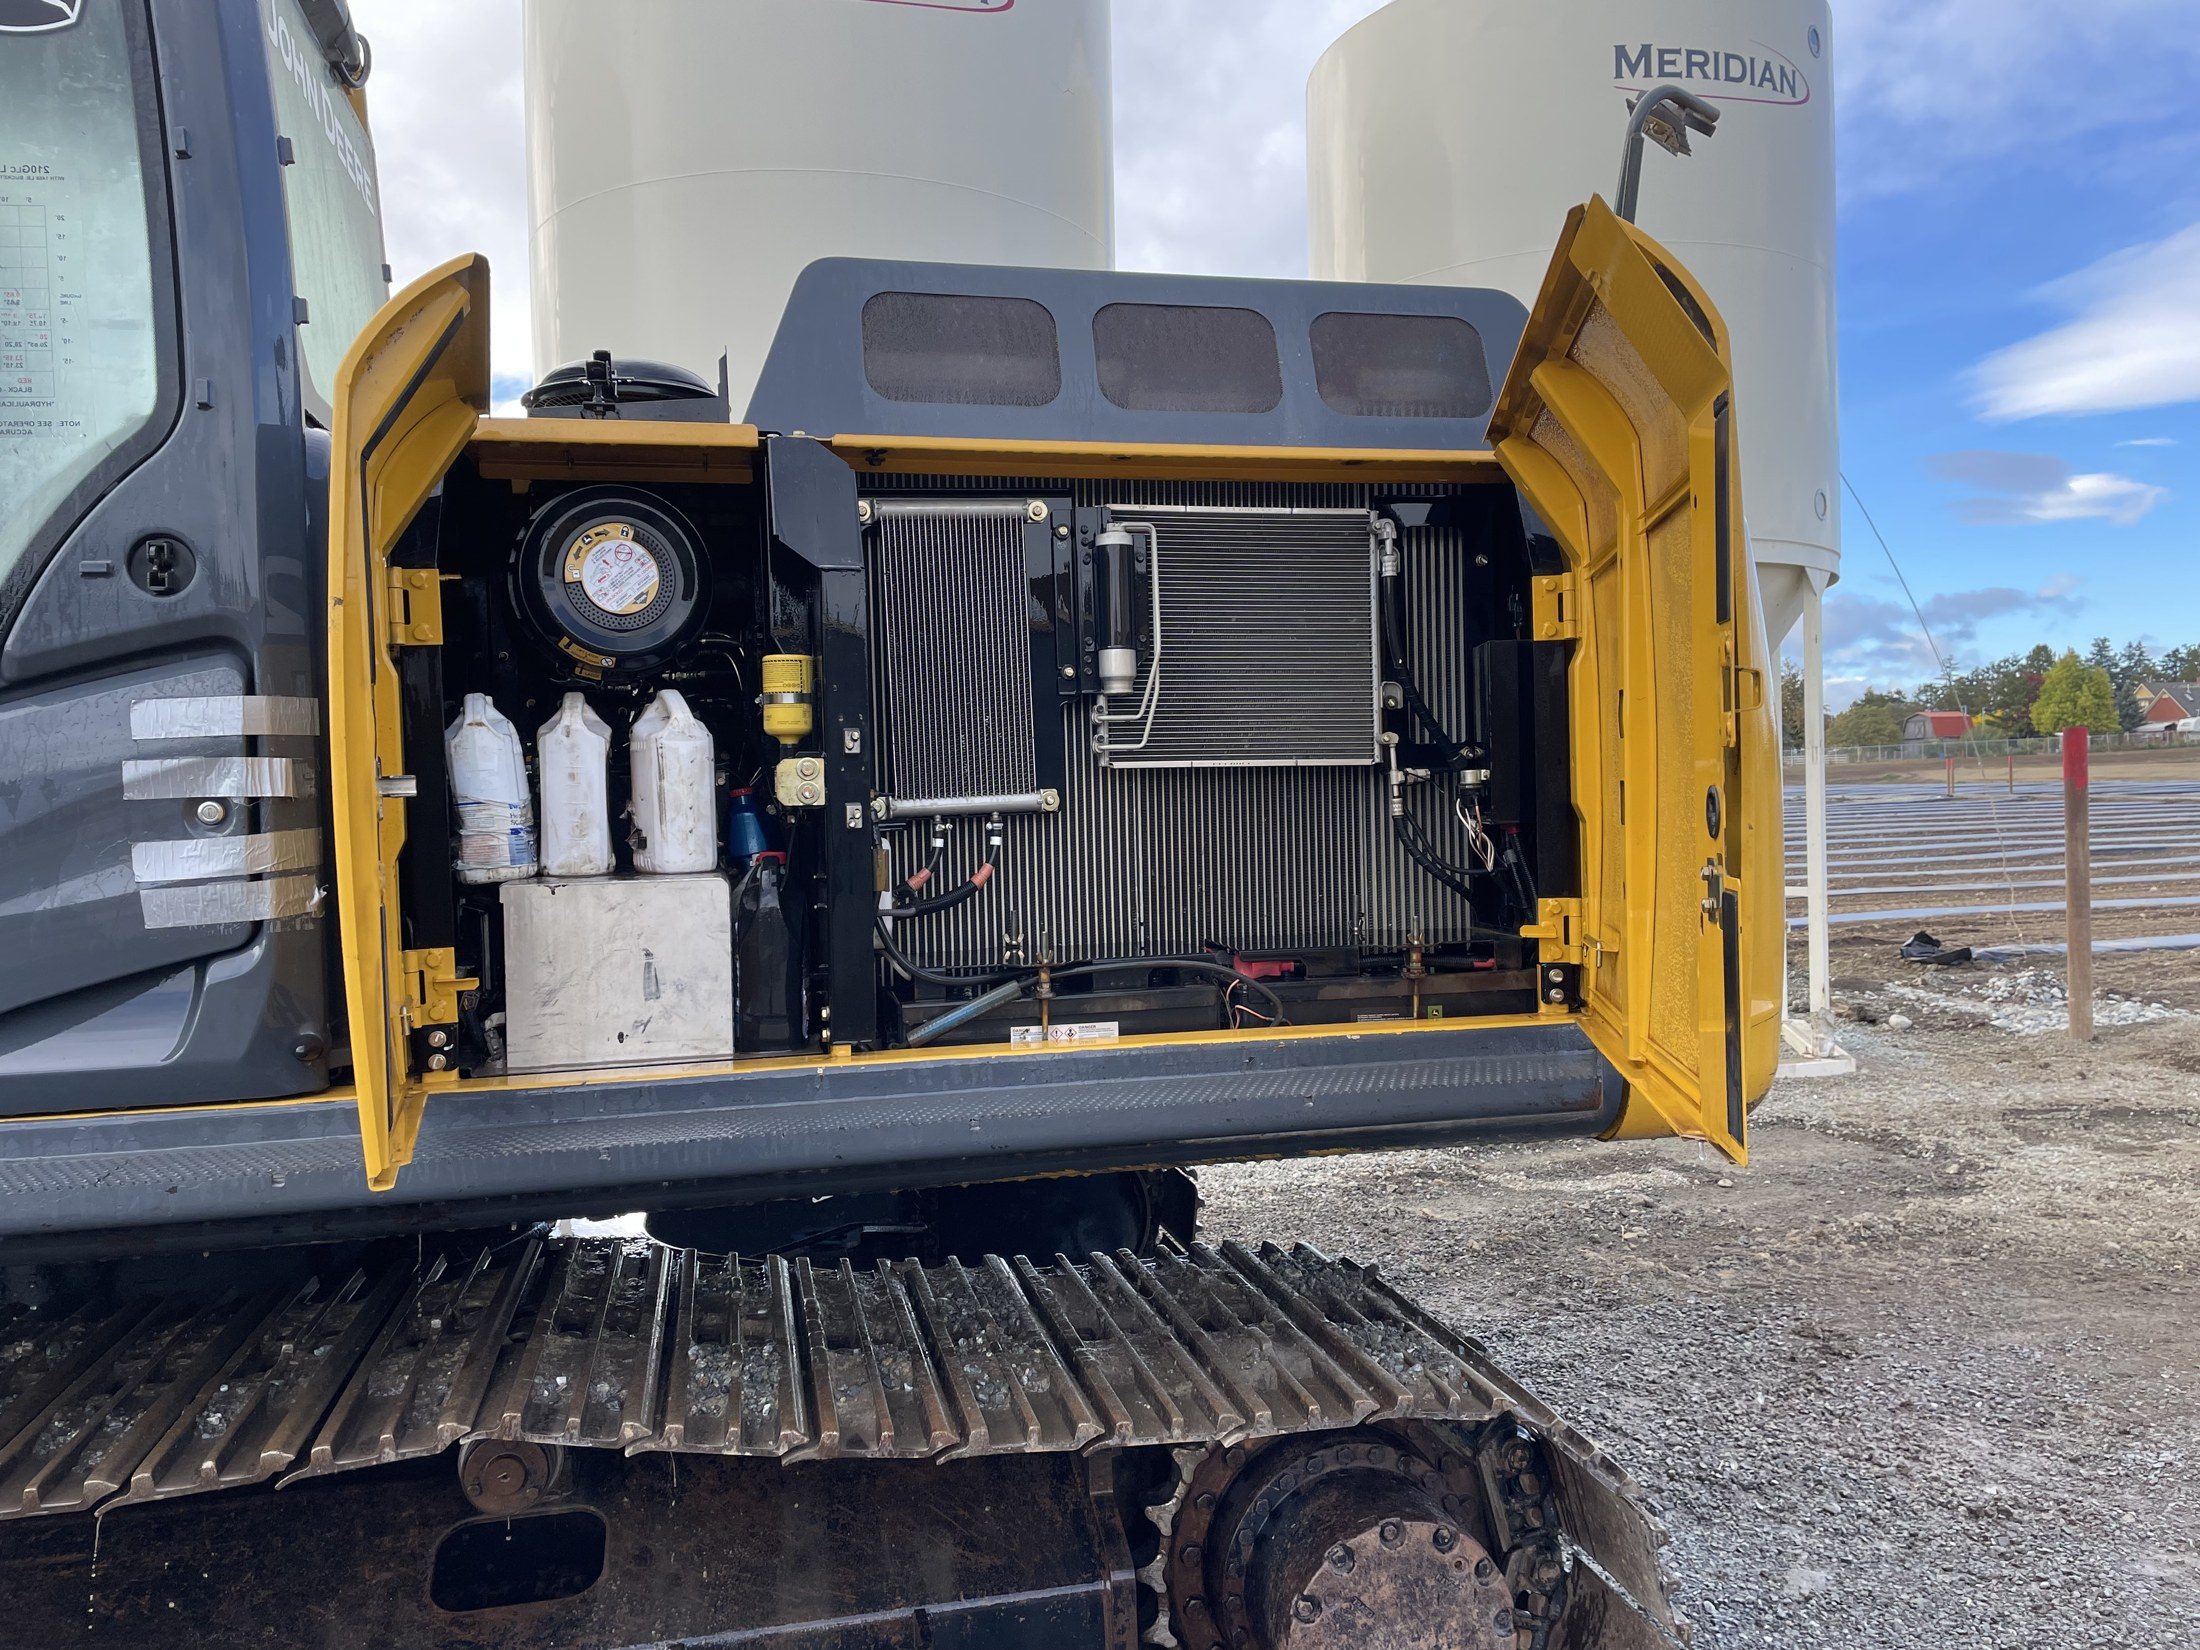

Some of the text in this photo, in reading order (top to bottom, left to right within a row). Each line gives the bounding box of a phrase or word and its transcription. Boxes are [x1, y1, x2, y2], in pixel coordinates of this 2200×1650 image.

[268, 0, 375, 216] JOHN DEERE
[1613, 43, 1797, 98] MERIDIAN
